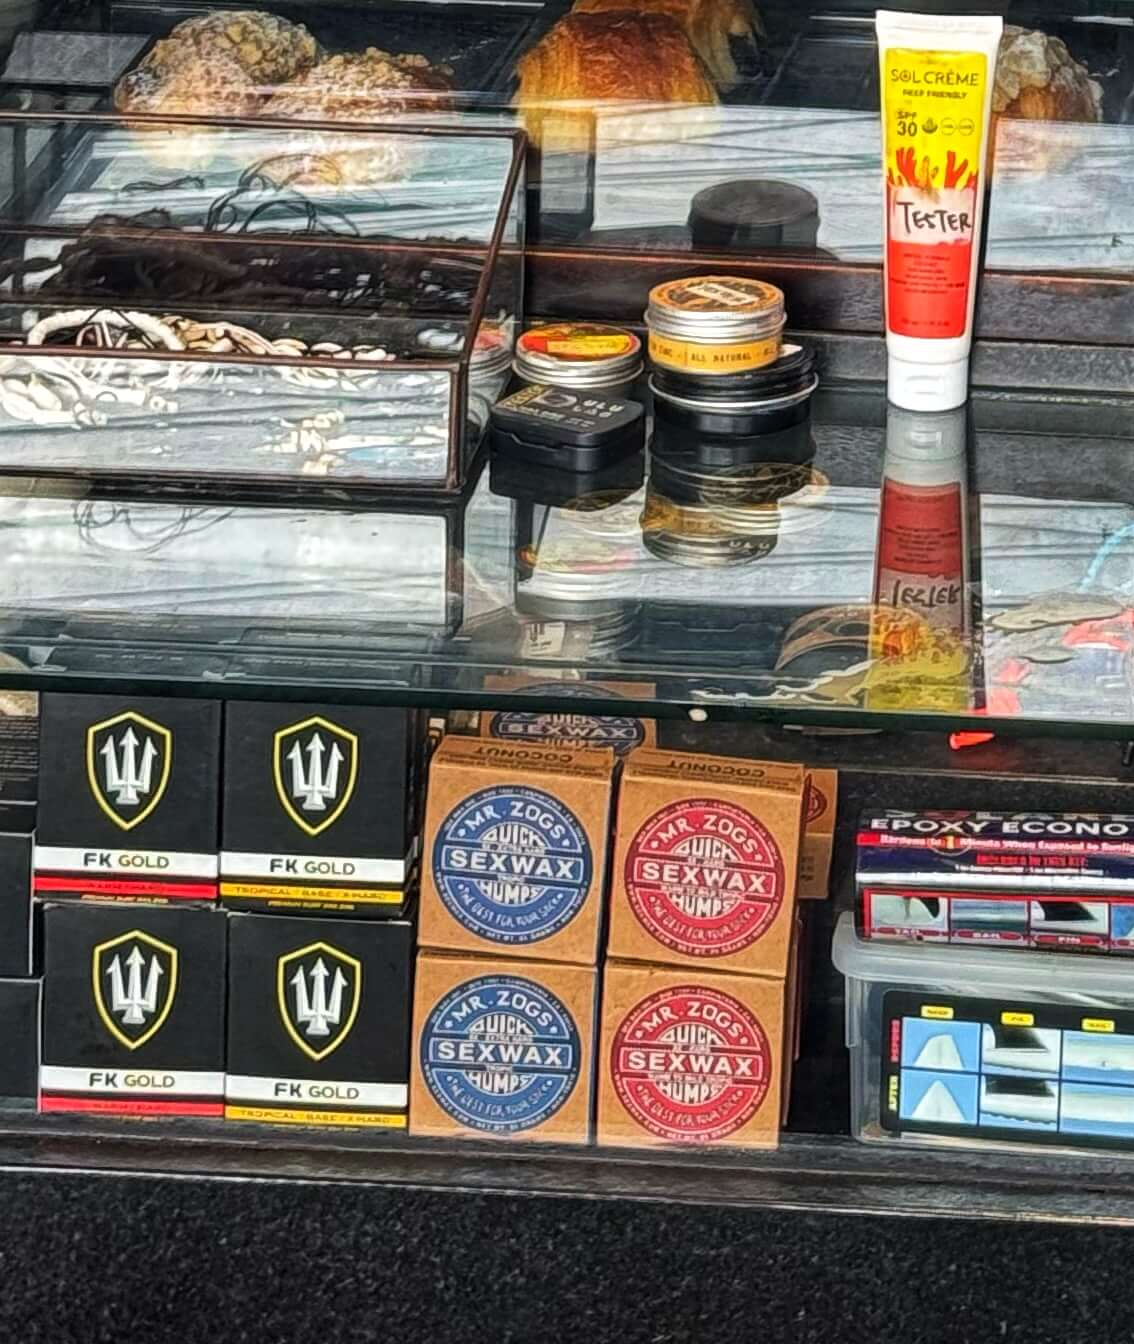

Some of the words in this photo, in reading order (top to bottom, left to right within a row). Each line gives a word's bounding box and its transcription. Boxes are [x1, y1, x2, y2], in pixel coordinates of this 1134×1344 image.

[890, 68, 921, 84] SOL
[896, 120, 918, 137] 30
[475, 747, 574, 764] COCONUT
[669, 760, 766, 779] COCONUT
[509, 800, 566, 839] ZOGS
[870, 817, 991, 833] EPOXY
[1001, 820, 1130, 835] ECONO
[481, 823, 546, 847] QUICK
[702, 814, 759, 853] ZOGS
[82, 852, 113, 868] FK
[118, 854, 170, 869] GOLD
[672, 838, 739, 861] QUICK
[269, 858, 299, 874] FK
[304, 860, 356, 876] GOLD
[449, 849, 574, 879] SEXWAX
[641, 862, 767, 893] SEXWAX
[234, 886, 291, 896] TROPICAL
[478, 881, 542, 904] HUMPS
[670, 894, 735, 918] HUMPS
[496, 990, 553, 1030] ZOGS
[687, 1001, 745, 1041] ZOGS
[468, 1014, 534, 1035] QUICK
[659, 1024, 725, 1046] QUICK
[437, 1040, 563, 1066] SEXWAX
[627, 1051, 753, 1076] SEXWAX
[88, 1072, 118, 1088] FK
[124, 1074, 175, 1089] GOLD
[273, 1082, 302, 1098] FK
[309, 1085, 360, 1101] GOLD
[467, 1071, 533, 1094] HUMPS
[658, 1082, 723, 1104] HUMPS
[240, 1110, 295, 1120] TROPICAL
